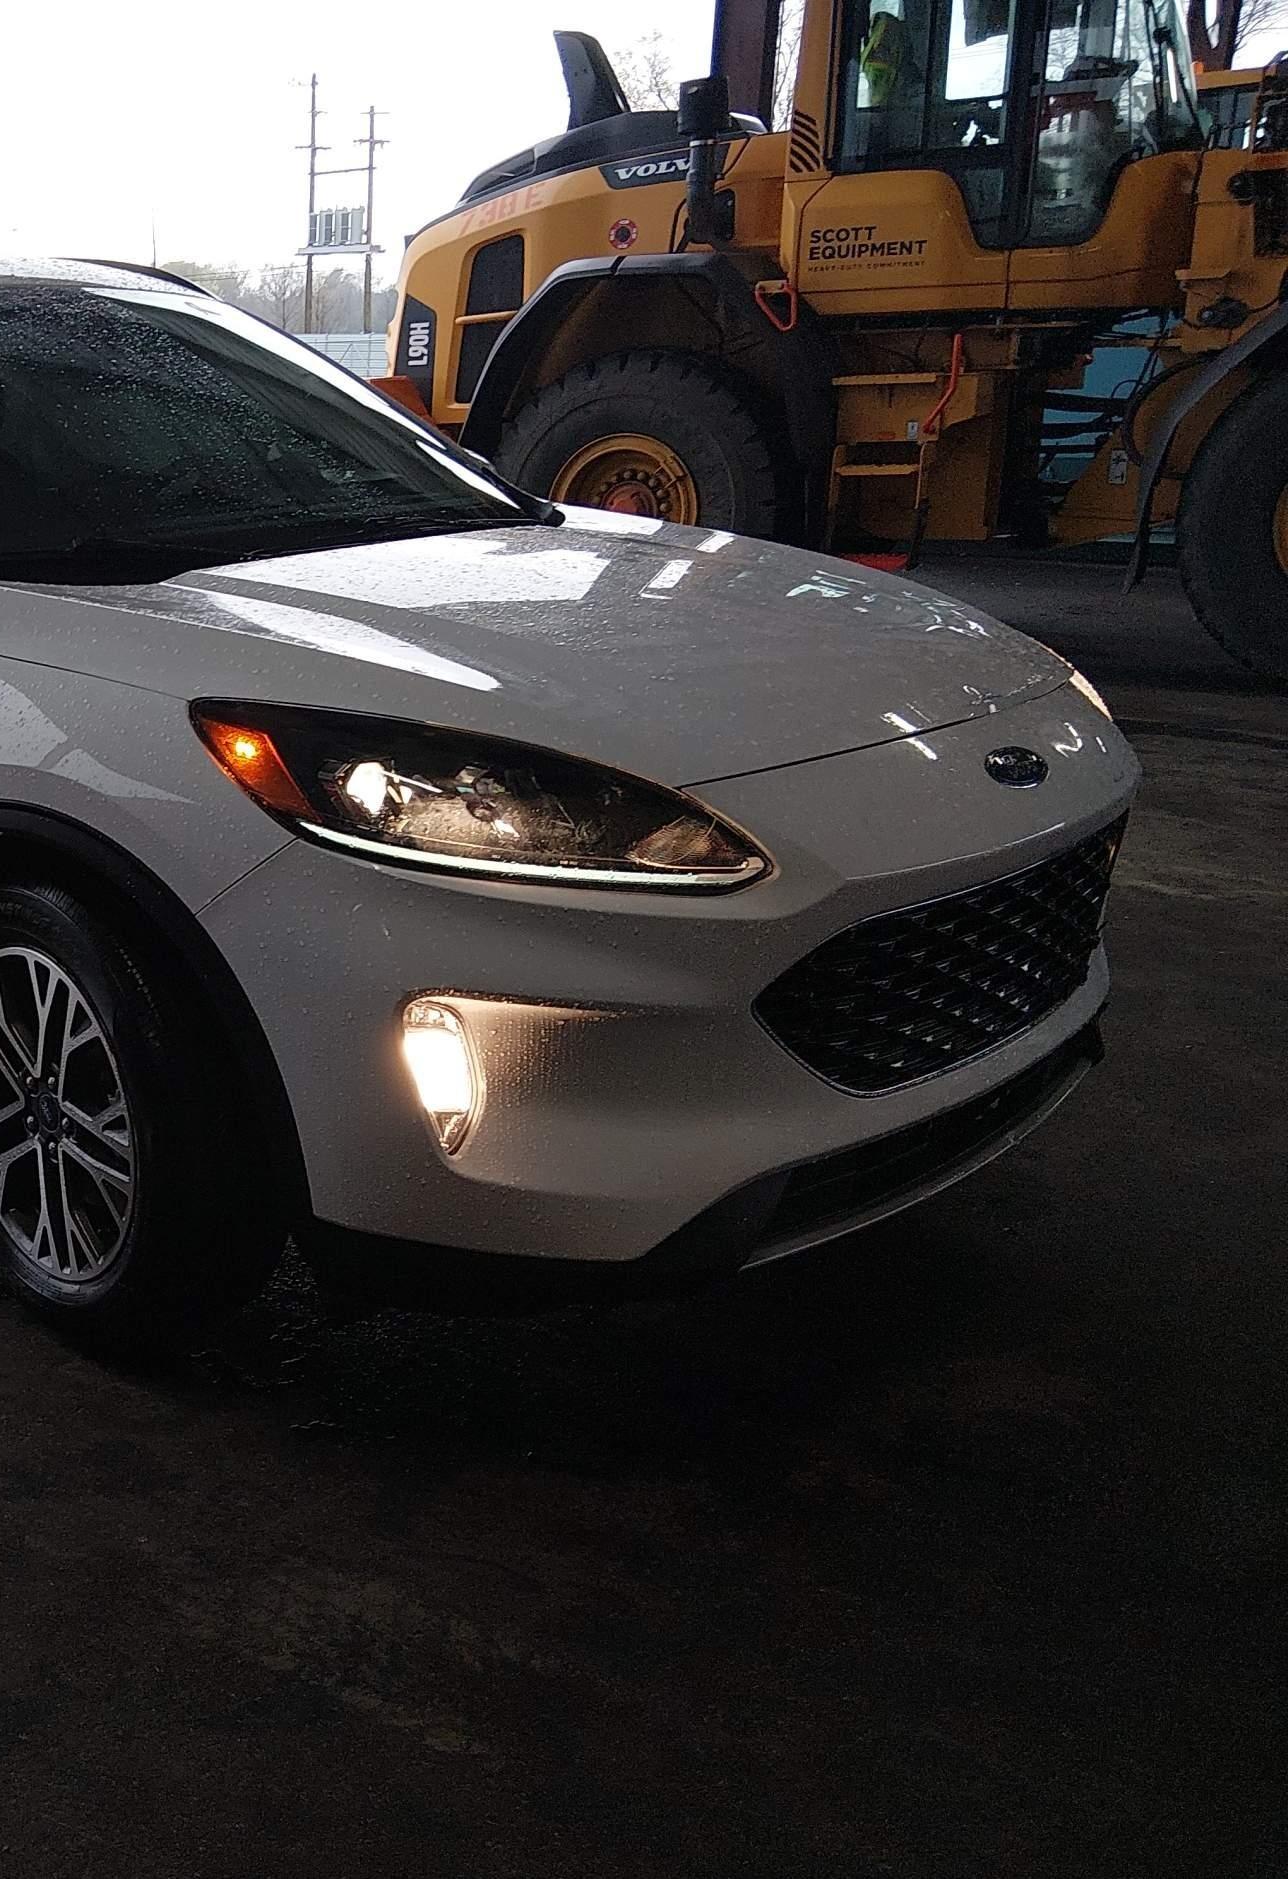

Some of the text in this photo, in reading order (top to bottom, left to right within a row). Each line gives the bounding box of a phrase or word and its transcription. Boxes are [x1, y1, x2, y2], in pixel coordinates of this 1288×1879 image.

[614, 158, 690, 180] VOLV
[809, 226, 877, 243] SCOTT
[808, 239, 928, 261] EQUIPMENT
[407, 322, 431, 366] L90H
